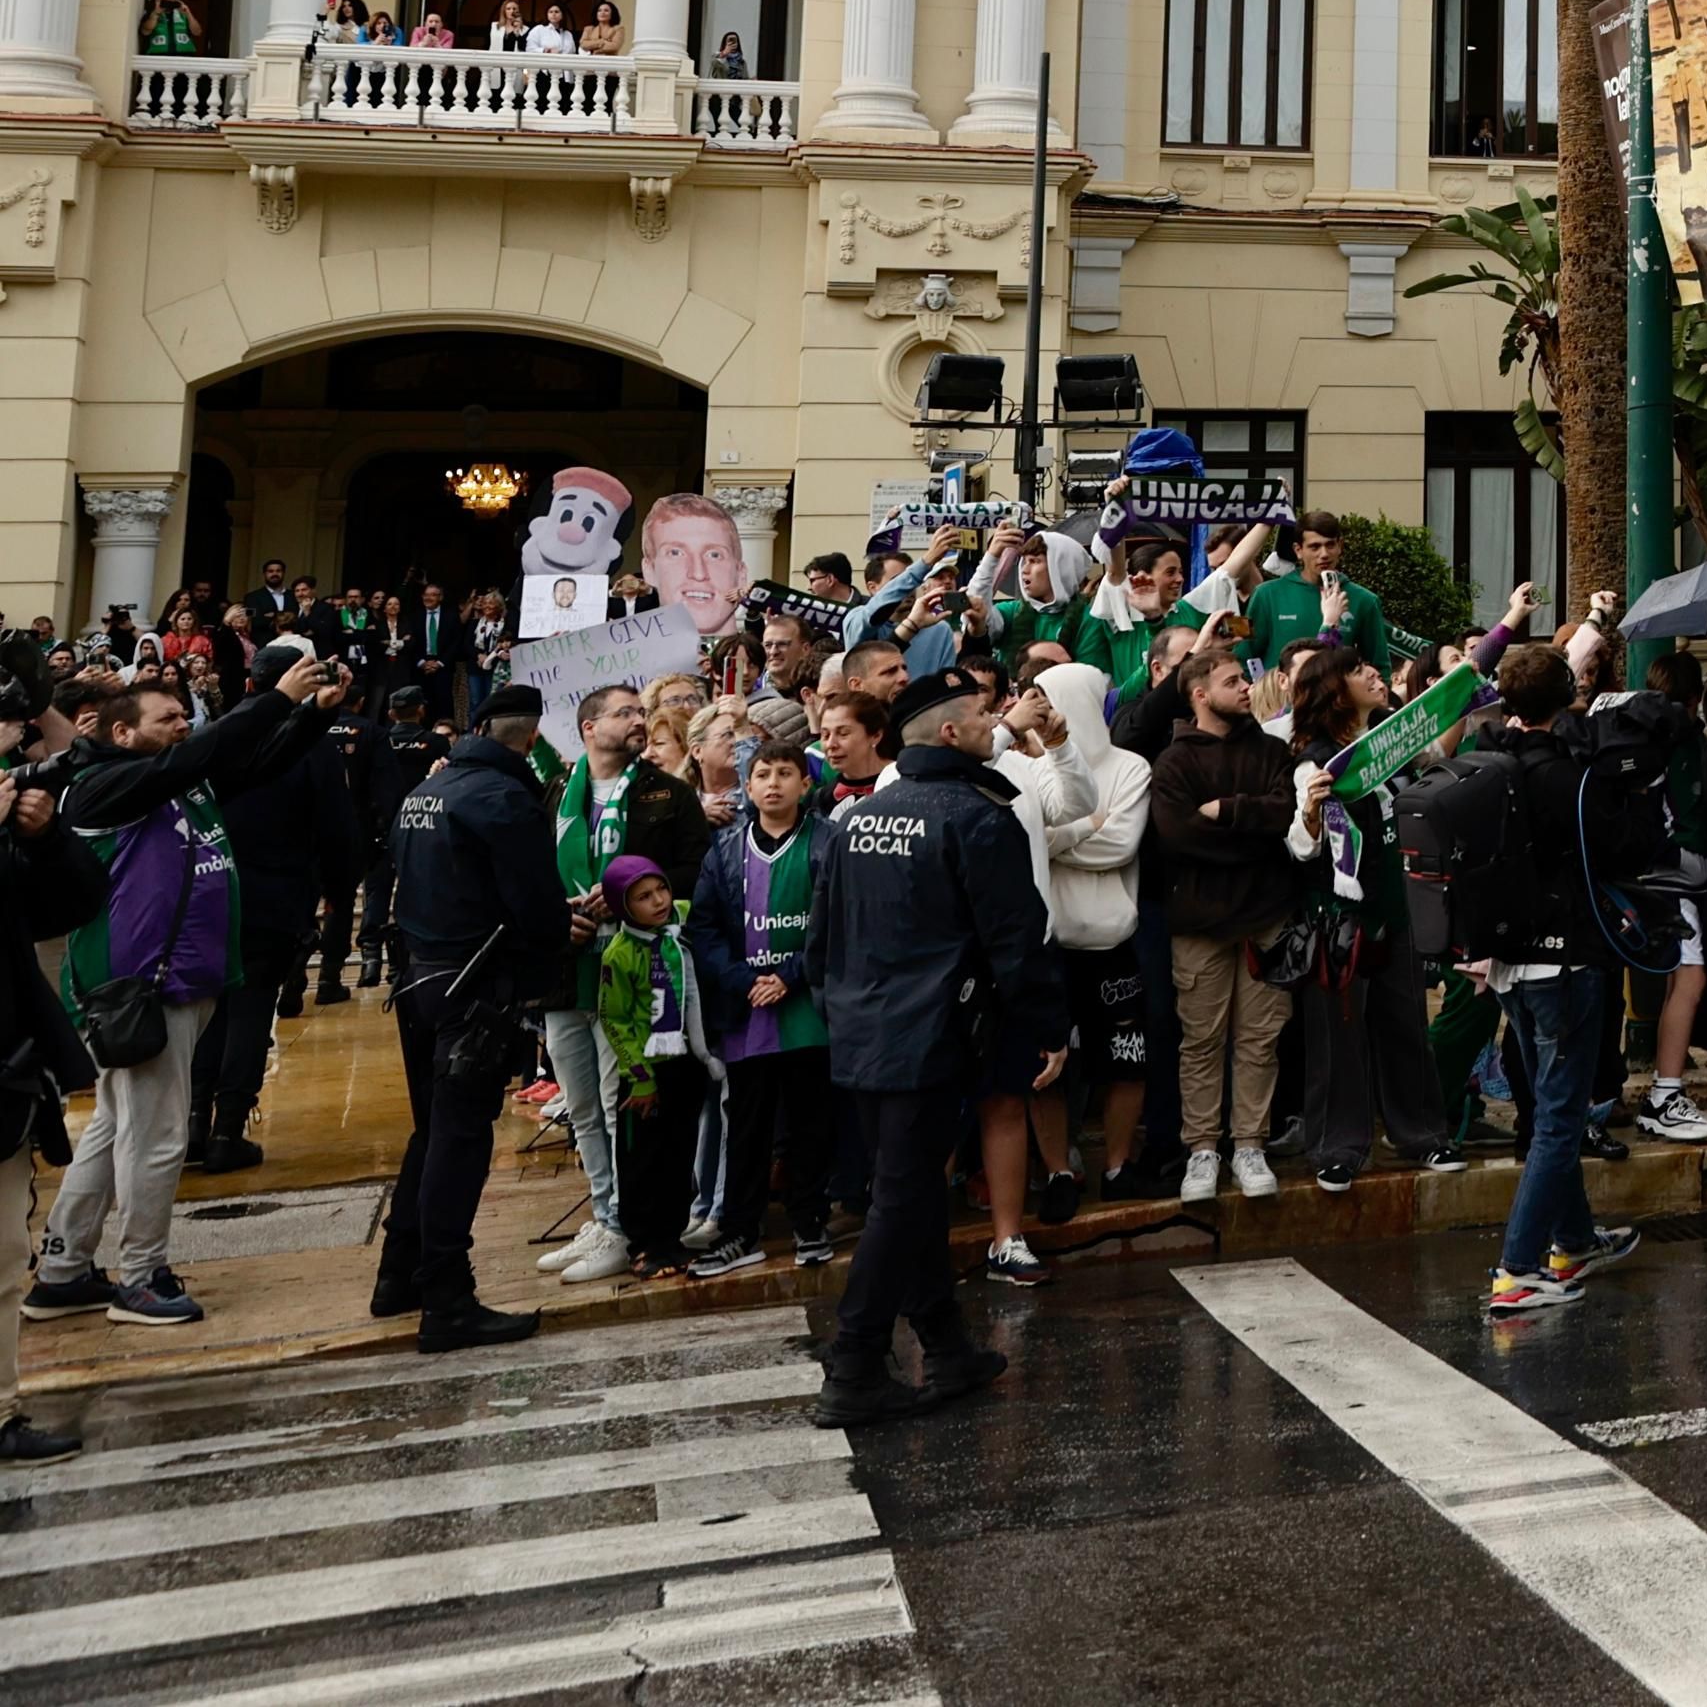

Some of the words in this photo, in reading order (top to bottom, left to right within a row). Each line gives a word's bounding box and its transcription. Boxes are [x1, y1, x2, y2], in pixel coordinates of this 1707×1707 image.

[905, 503, 1004, 515] UNICAJ
[1131, 478, 1297, 523] UNICAJA
[519, 630, 595, 667] CARTER
[609, 612, 673, 644] GIVE
[585, 649, 641, 676] YOUR
[1367, 702, 1428, 759] UNICAJA
[1359, 713, 1439, 790] BALONCESTO
[400, 813, 436, 829] LOCAL
[846, 814, 926, 838] POLICIA
[848, 835, 913, 857] LOCAL
